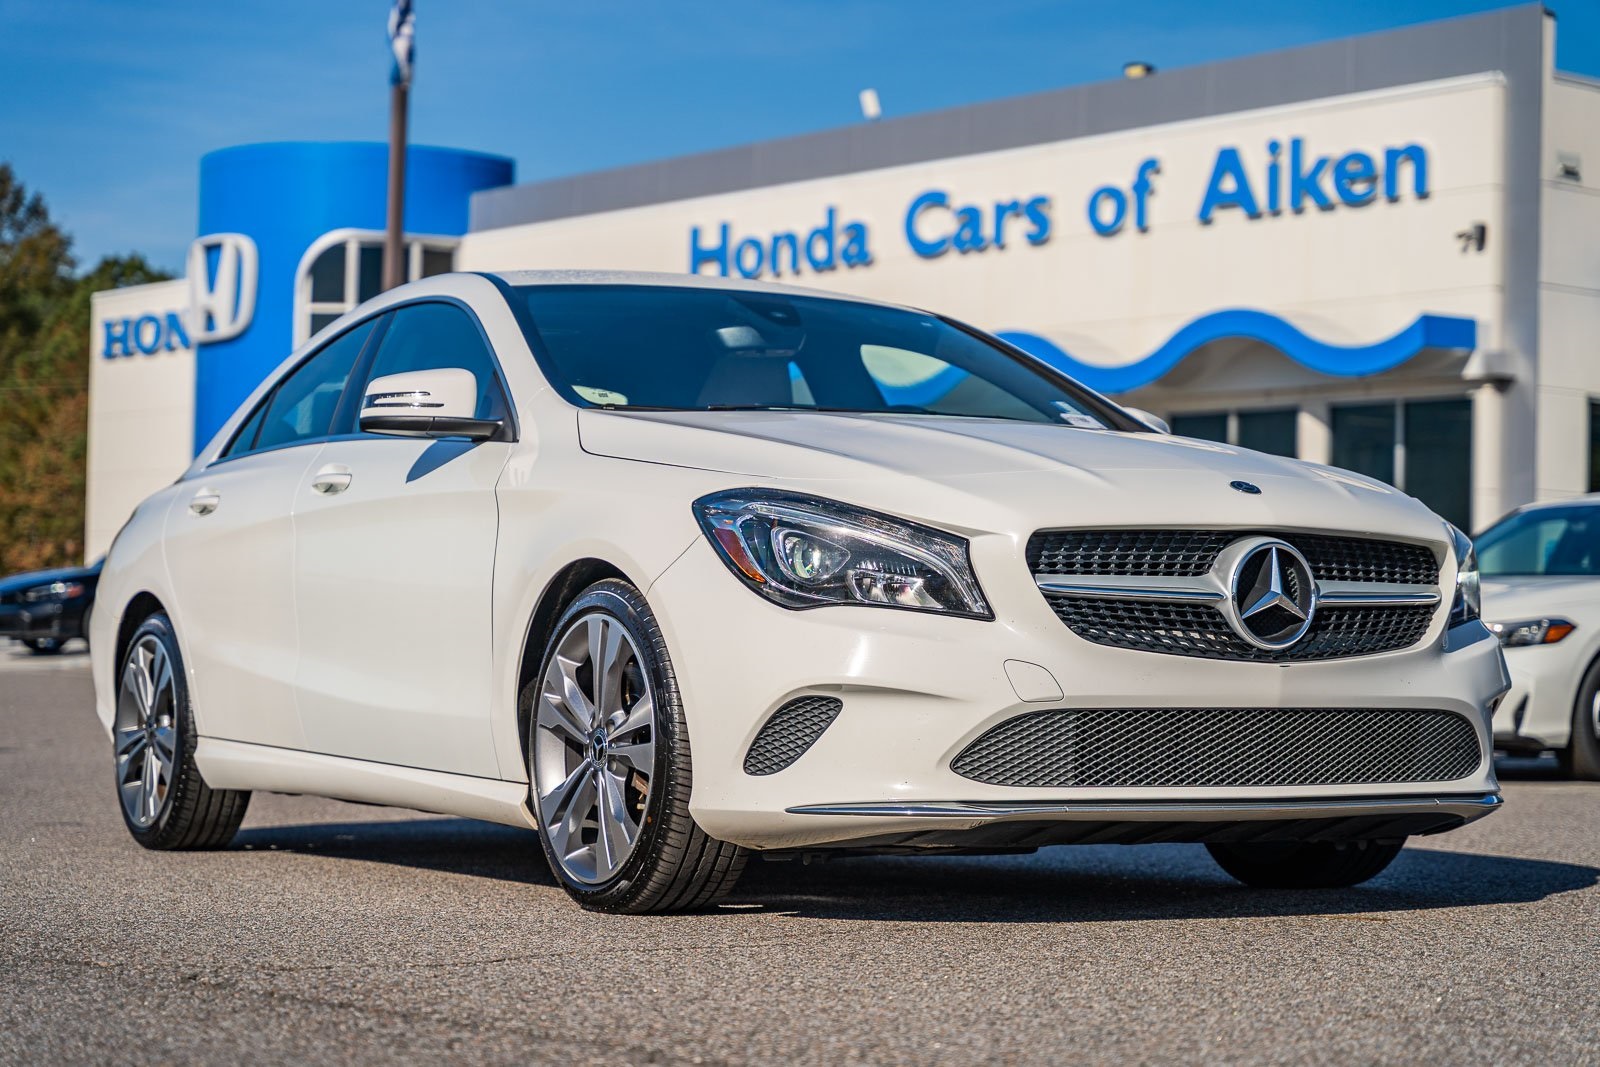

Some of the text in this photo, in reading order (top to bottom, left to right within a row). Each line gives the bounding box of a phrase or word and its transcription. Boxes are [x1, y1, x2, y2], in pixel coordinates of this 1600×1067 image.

[690, 137, 1430, 280] Honda Cars of Aiken
